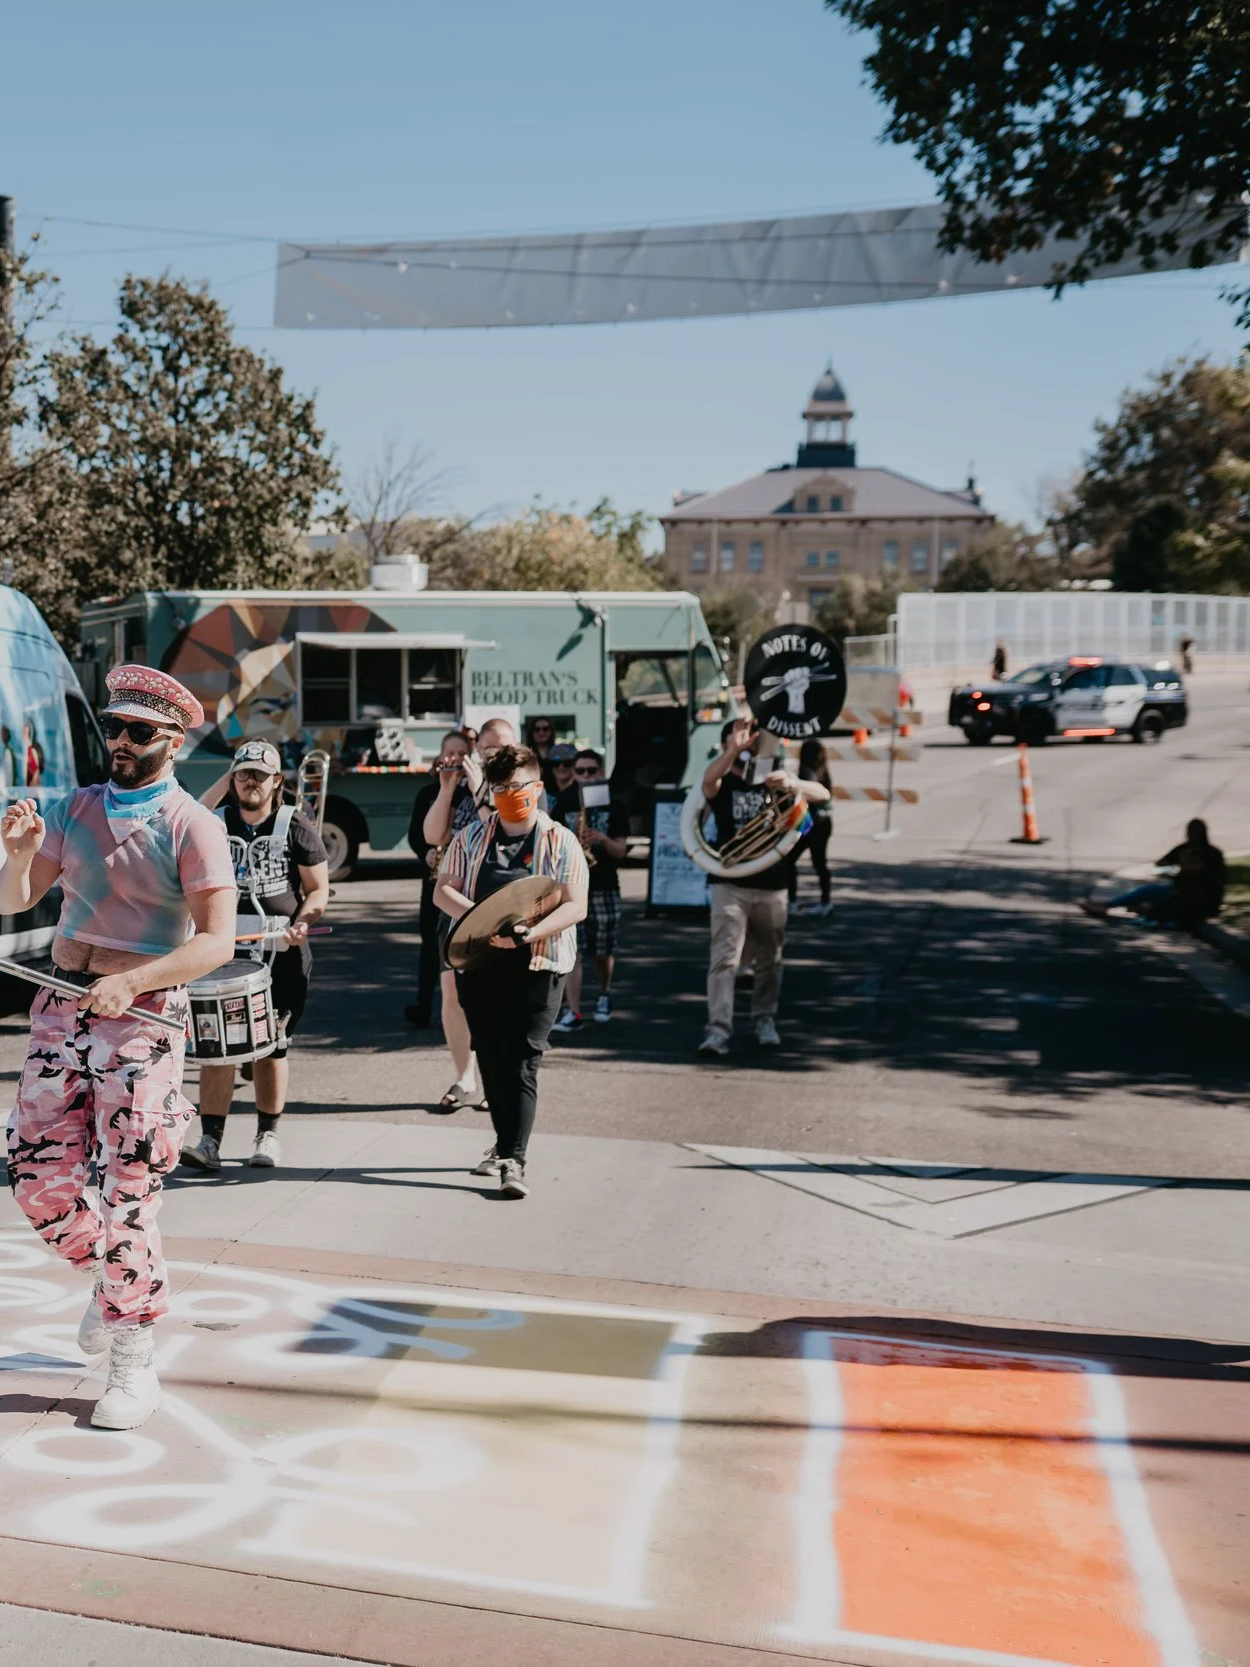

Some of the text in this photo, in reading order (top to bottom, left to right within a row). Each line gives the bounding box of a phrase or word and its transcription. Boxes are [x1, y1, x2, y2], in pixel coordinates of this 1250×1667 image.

[761, 634, 808, 659] NOTES
[471, 671, 578, 687] BELTRAN'S
[471, 688, 598, 705] FOOD TRUCK
[767, 715, 821, 737] DISSENT
